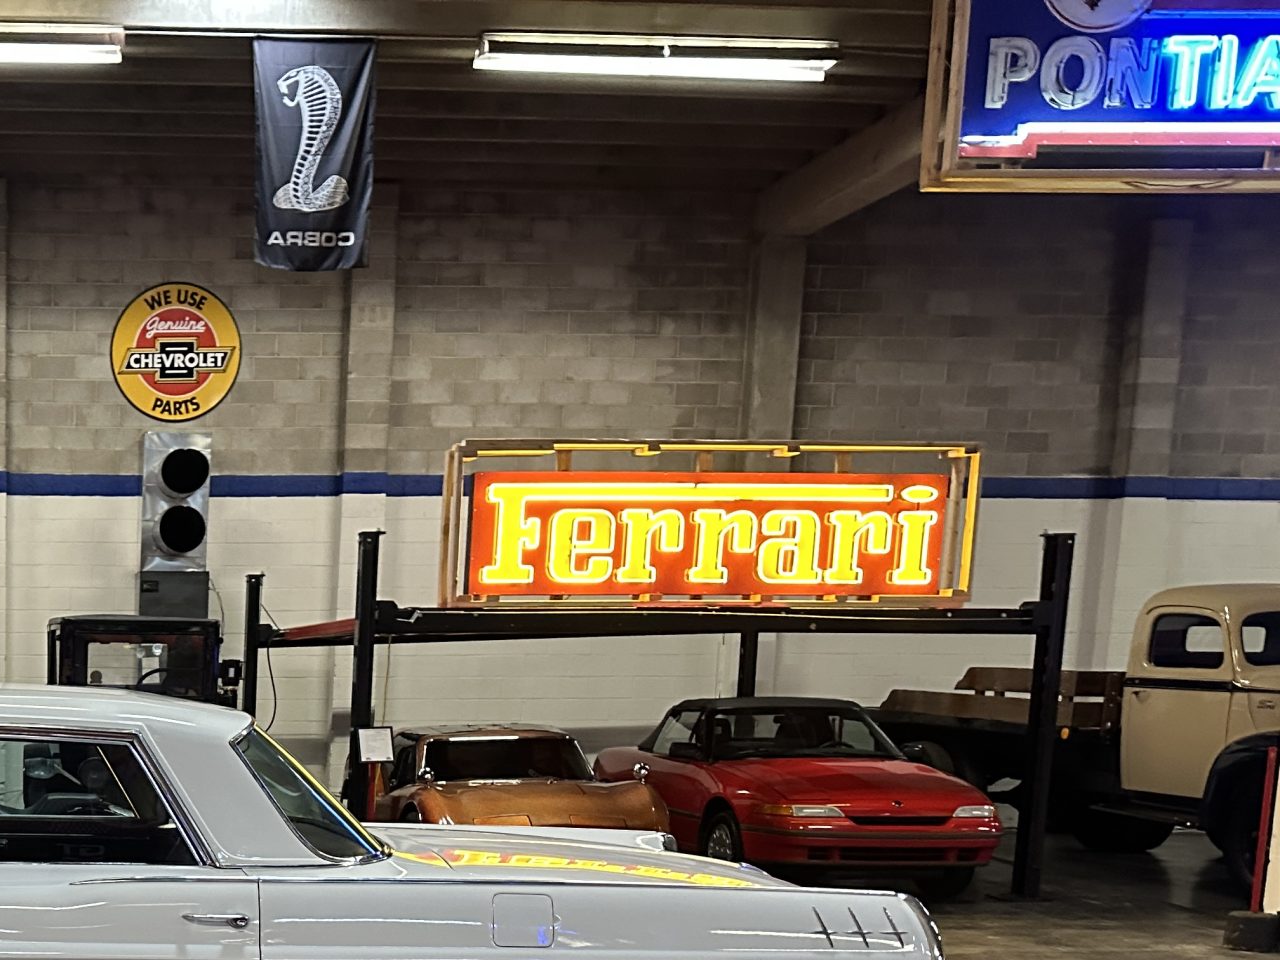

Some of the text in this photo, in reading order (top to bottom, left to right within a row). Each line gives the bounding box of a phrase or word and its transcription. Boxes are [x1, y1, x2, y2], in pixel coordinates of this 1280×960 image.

[144, 289, 208, 311] WE USE
[145, 316, 207, 339] Genuine
[129, 352, 224, 368] CHEVROLET
[152, 396, 201, 415] PARTS
[479, 483, 939, 585] Ferrari
